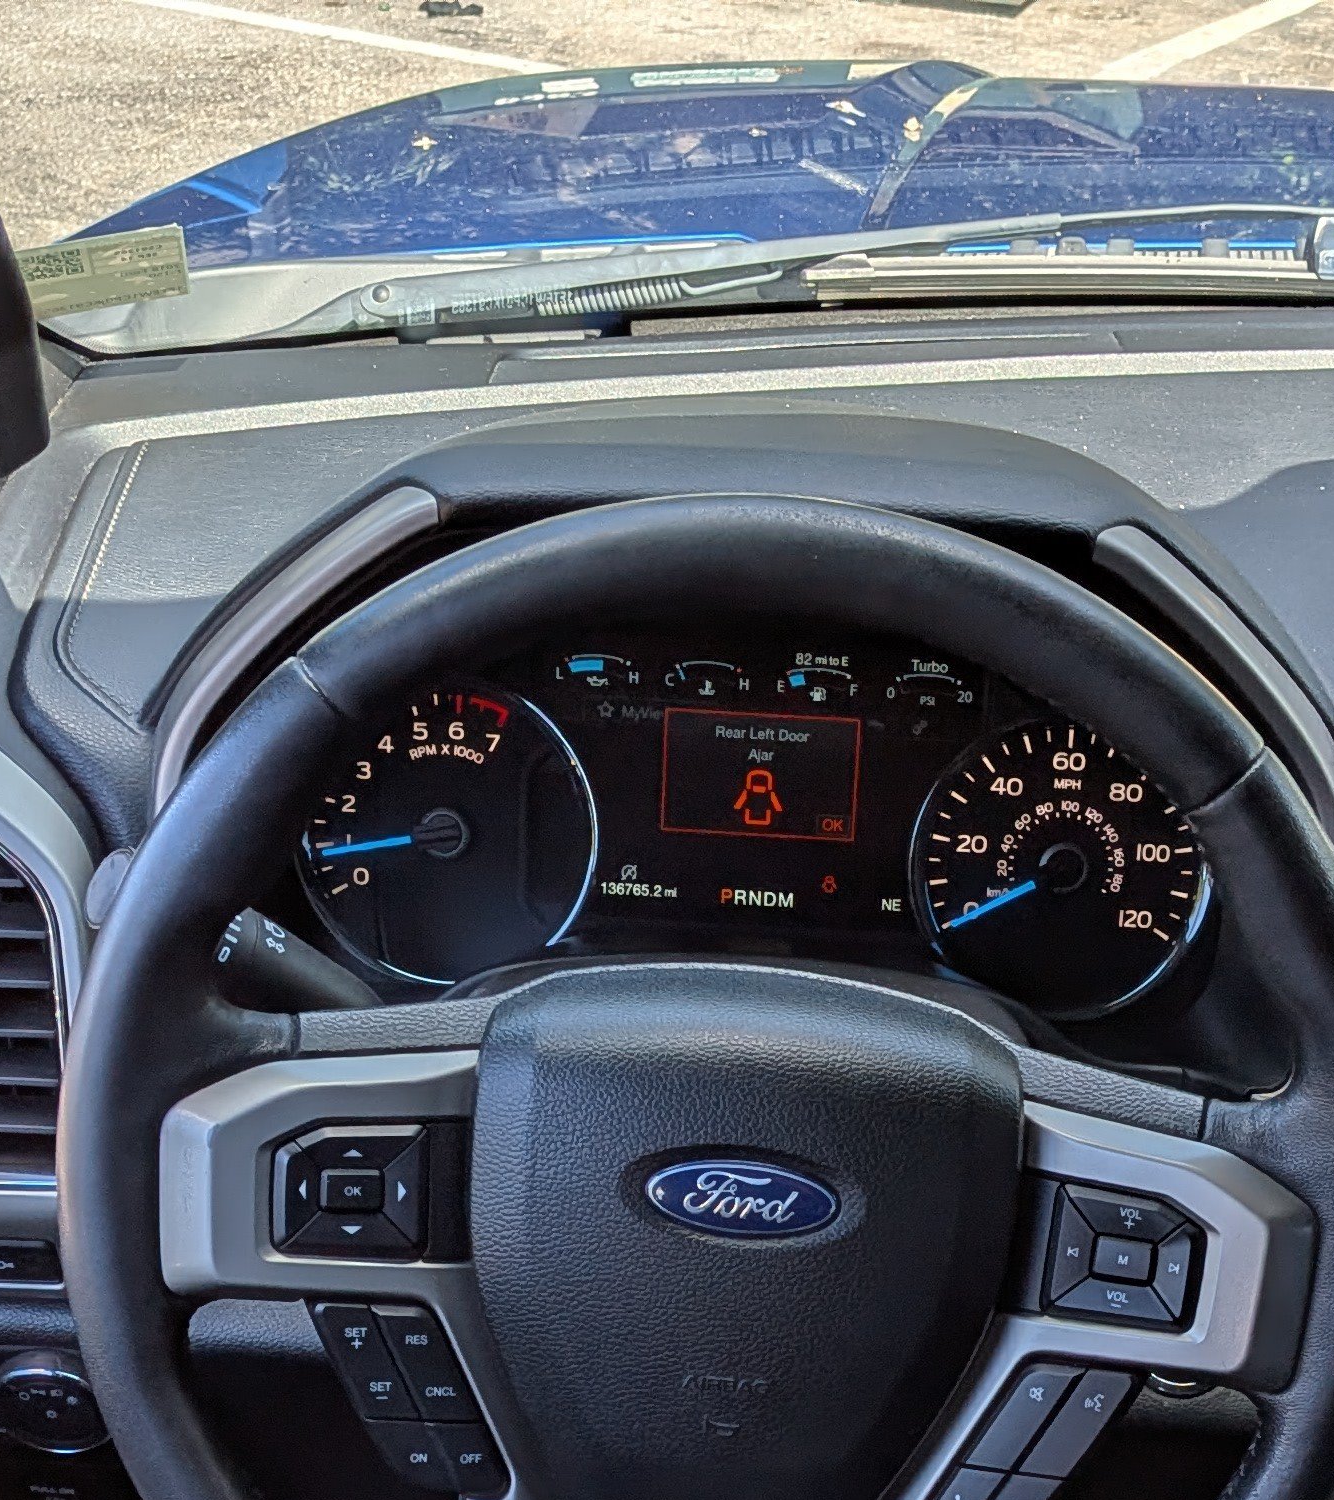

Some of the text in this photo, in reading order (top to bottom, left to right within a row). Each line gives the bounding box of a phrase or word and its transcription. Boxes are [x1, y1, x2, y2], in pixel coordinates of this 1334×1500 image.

[795, 653, 849, 666] 82 mi to E
[911, 659, 949, 673] Turbo
[555, 667, 564, 680] L
[628, 671, 640, 684] H
[665, 673, 675, 686] C
[739, 678, 750, 691] H
[777, 680, 785, 693] E
[850, 684, 858, 697] F
[886, 687, 896, 699] 0
[957, 690, 973, 703] 20
[412, 722, 428, 740] 5
[448, 722, 464, 740] 6
[715, 725, 810, 743] Rear Left Door
[377, 735, 395, 753] 4
[485, 733, 501, 752] 7
[408, 744, 484, 765] RPM X 1000
[748, 749, 774, 763] Ajar
[1052, 752, 1086, 771] 60
[356, 761, 371, 780] 3
[990, 777, 1023, 796] 40
[1053, 778, 1082, 790] MPH
[1109, 783, 1143, 802] 80
[341, 794, 357, 813] 2
[1035, 802, 1054, 816] 80
[1061, 800, 1080, 813] 100
[1015, 813, 1031, 830] 60
[1085, 806, 1103, 824] 120
[821, 818, 844, 832] OK
[1103, 823, 1119, 843] 140
[956, 835, 988, 853] 20
[1001, 834, 1015, 853] 40
[1136, 843, 1171, 863] 100
[997, 859, 1007, 877] 20
[353, 867, 369, 885] 0
[600, 882, 662, 898] 136765.2
[881, 898, 902, 912] NE
[1118, 909, 1152, 929] 120
[343, 1184, 363, 1197] OK
[681, 1169, 800, 1225] Ford
[1119, 1206, 1142, 1221] VOL
[1117, 1254, 1129, 1267] M
[1106, 1290, 1129, 1304] VOL
[344, 1326, 368, 1339] SET
[405, 1333, 429, 1346] RES
[368, 1380, 393, 1393] SET
[424, 1385, 457, 1398] CNCL
[410, 1452, 428, 1465] ON
[459, 1452, 483, 1466] OFF
